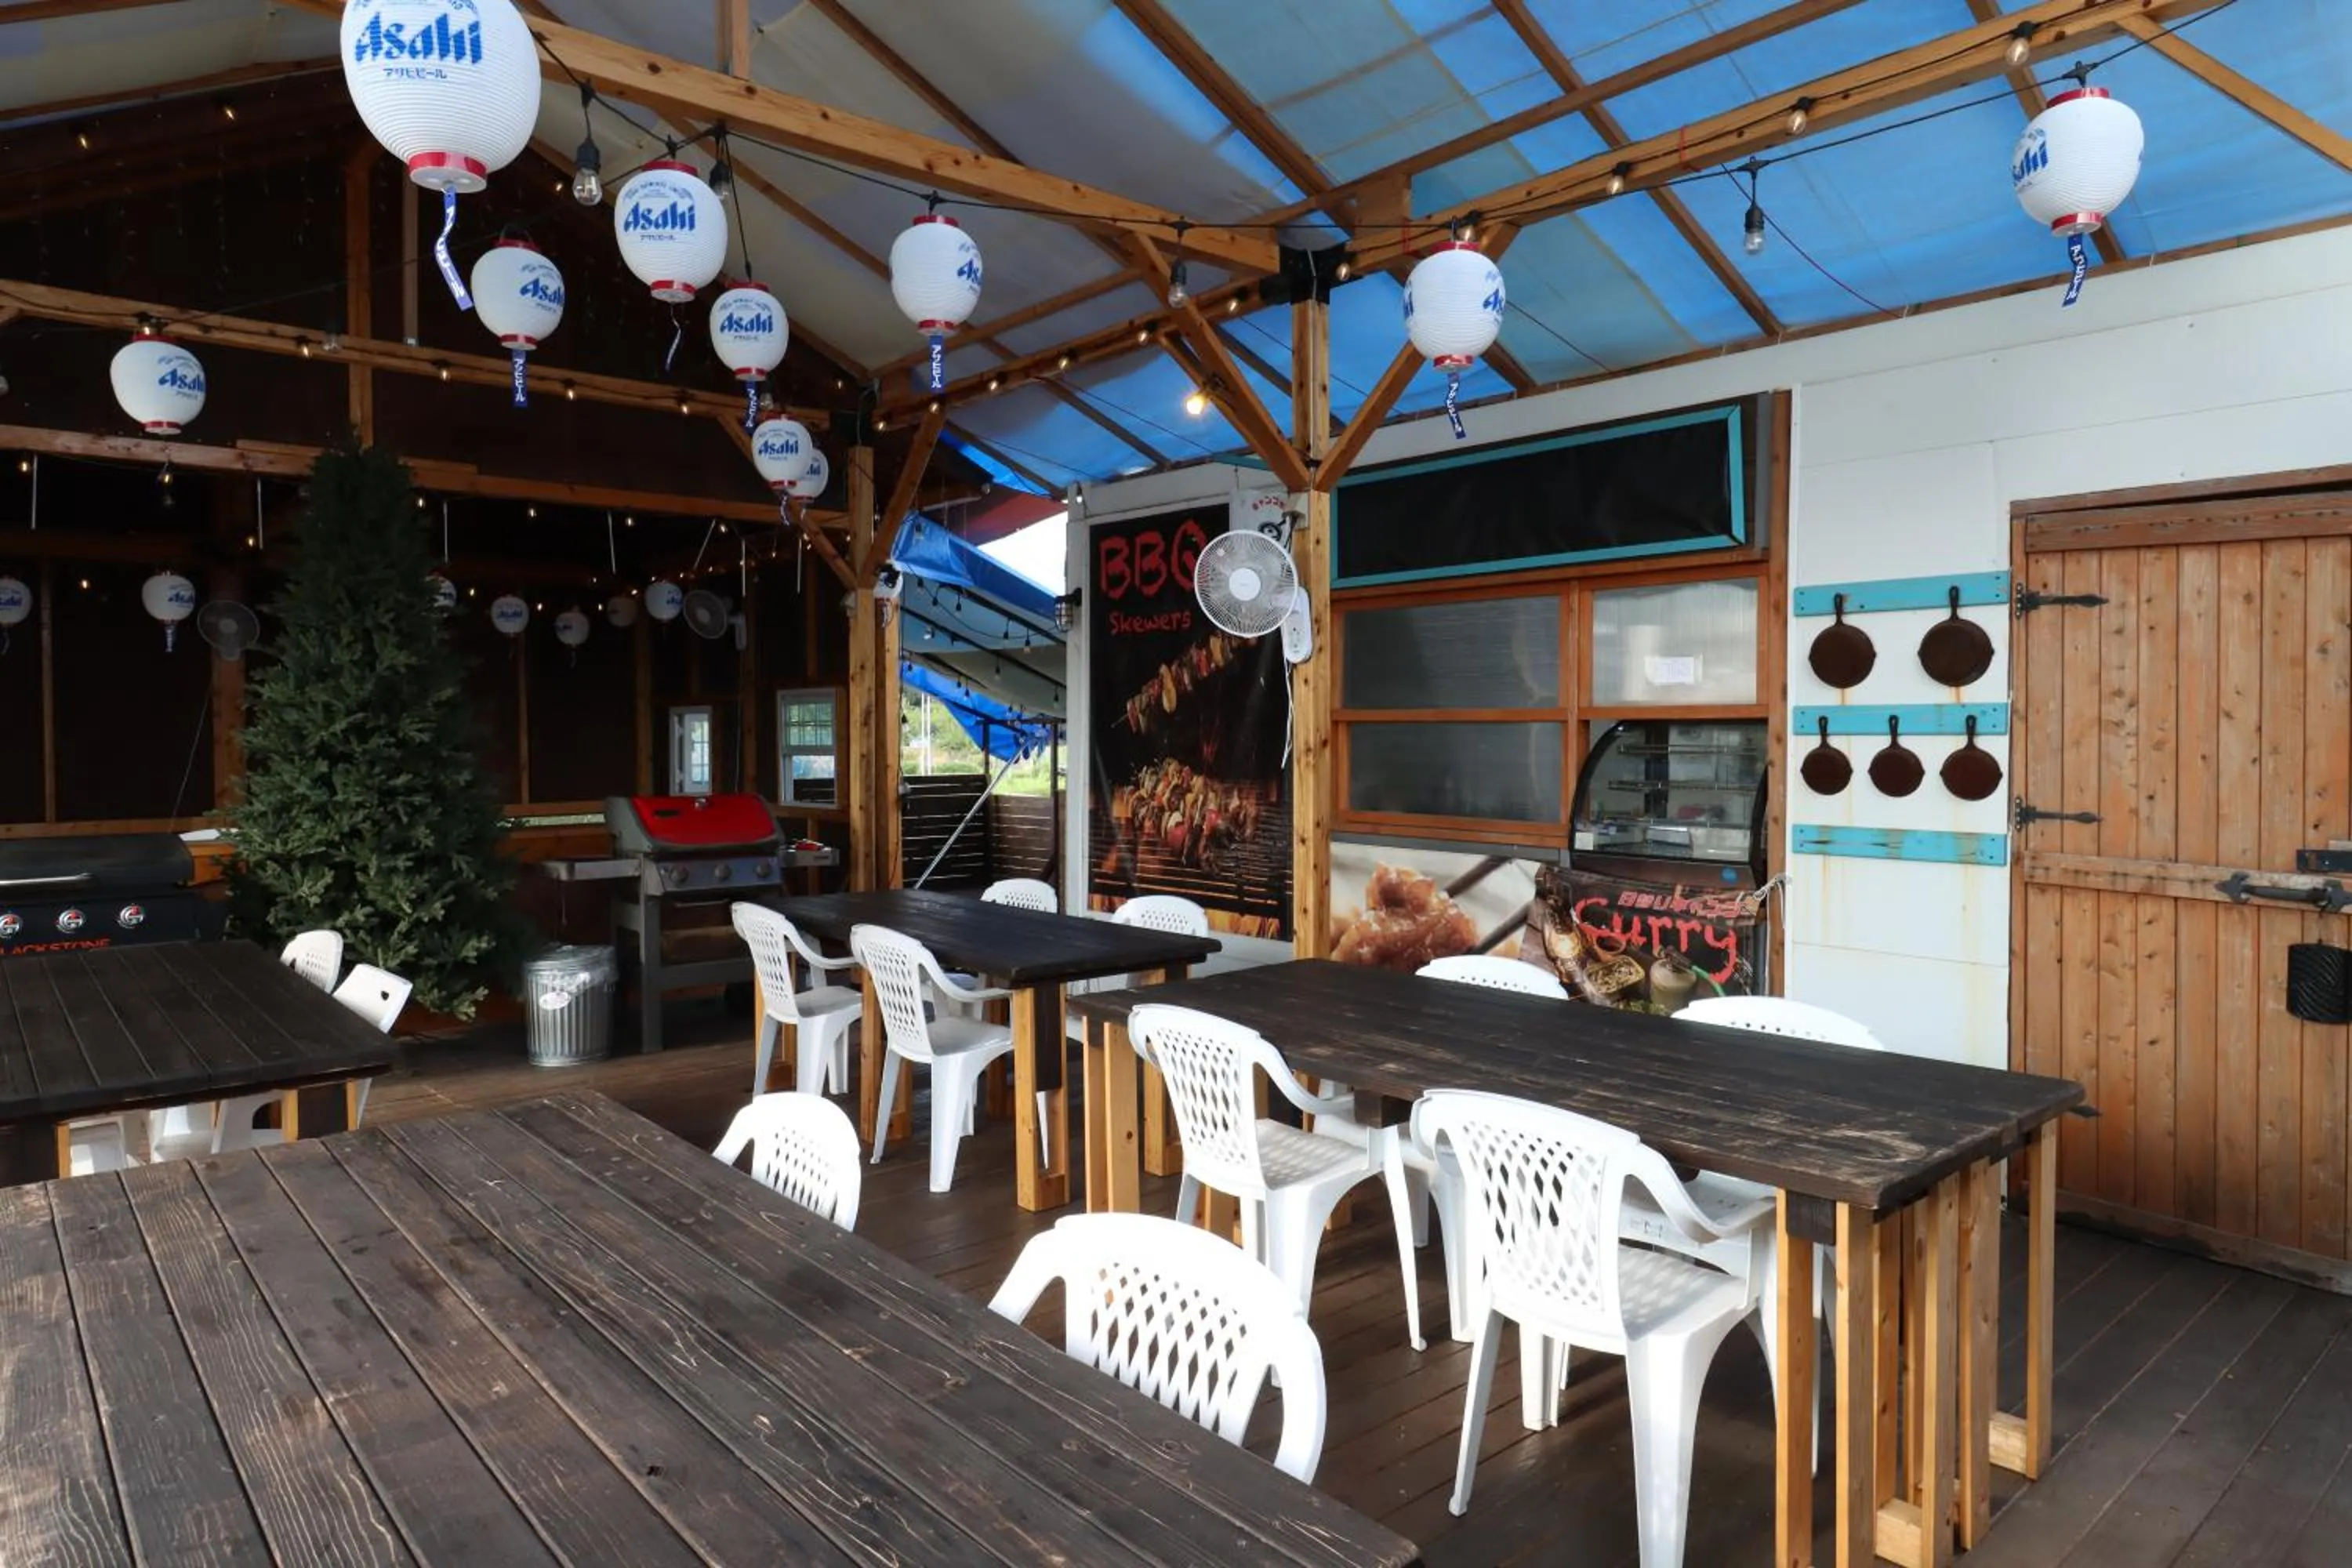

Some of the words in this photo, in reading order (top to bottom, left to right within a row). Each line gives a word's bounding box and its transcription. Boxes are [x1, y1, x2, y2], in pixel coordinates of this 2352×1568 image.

[355, 12, 482, 64] Asahi
[623, 201, 696, 233] Asahi
[520, 278, 564, 306] Asah
[719, 312, 773, 334] Asahi
[758, 439, 799, 456] Asahi
[1099, 519, 1212, 600] BBQ
[1109, 610, 1192, 635] Skewers
[0, 938, 110, 955] LACKSTONE
[1573, 898, 1737, 984] Curry
